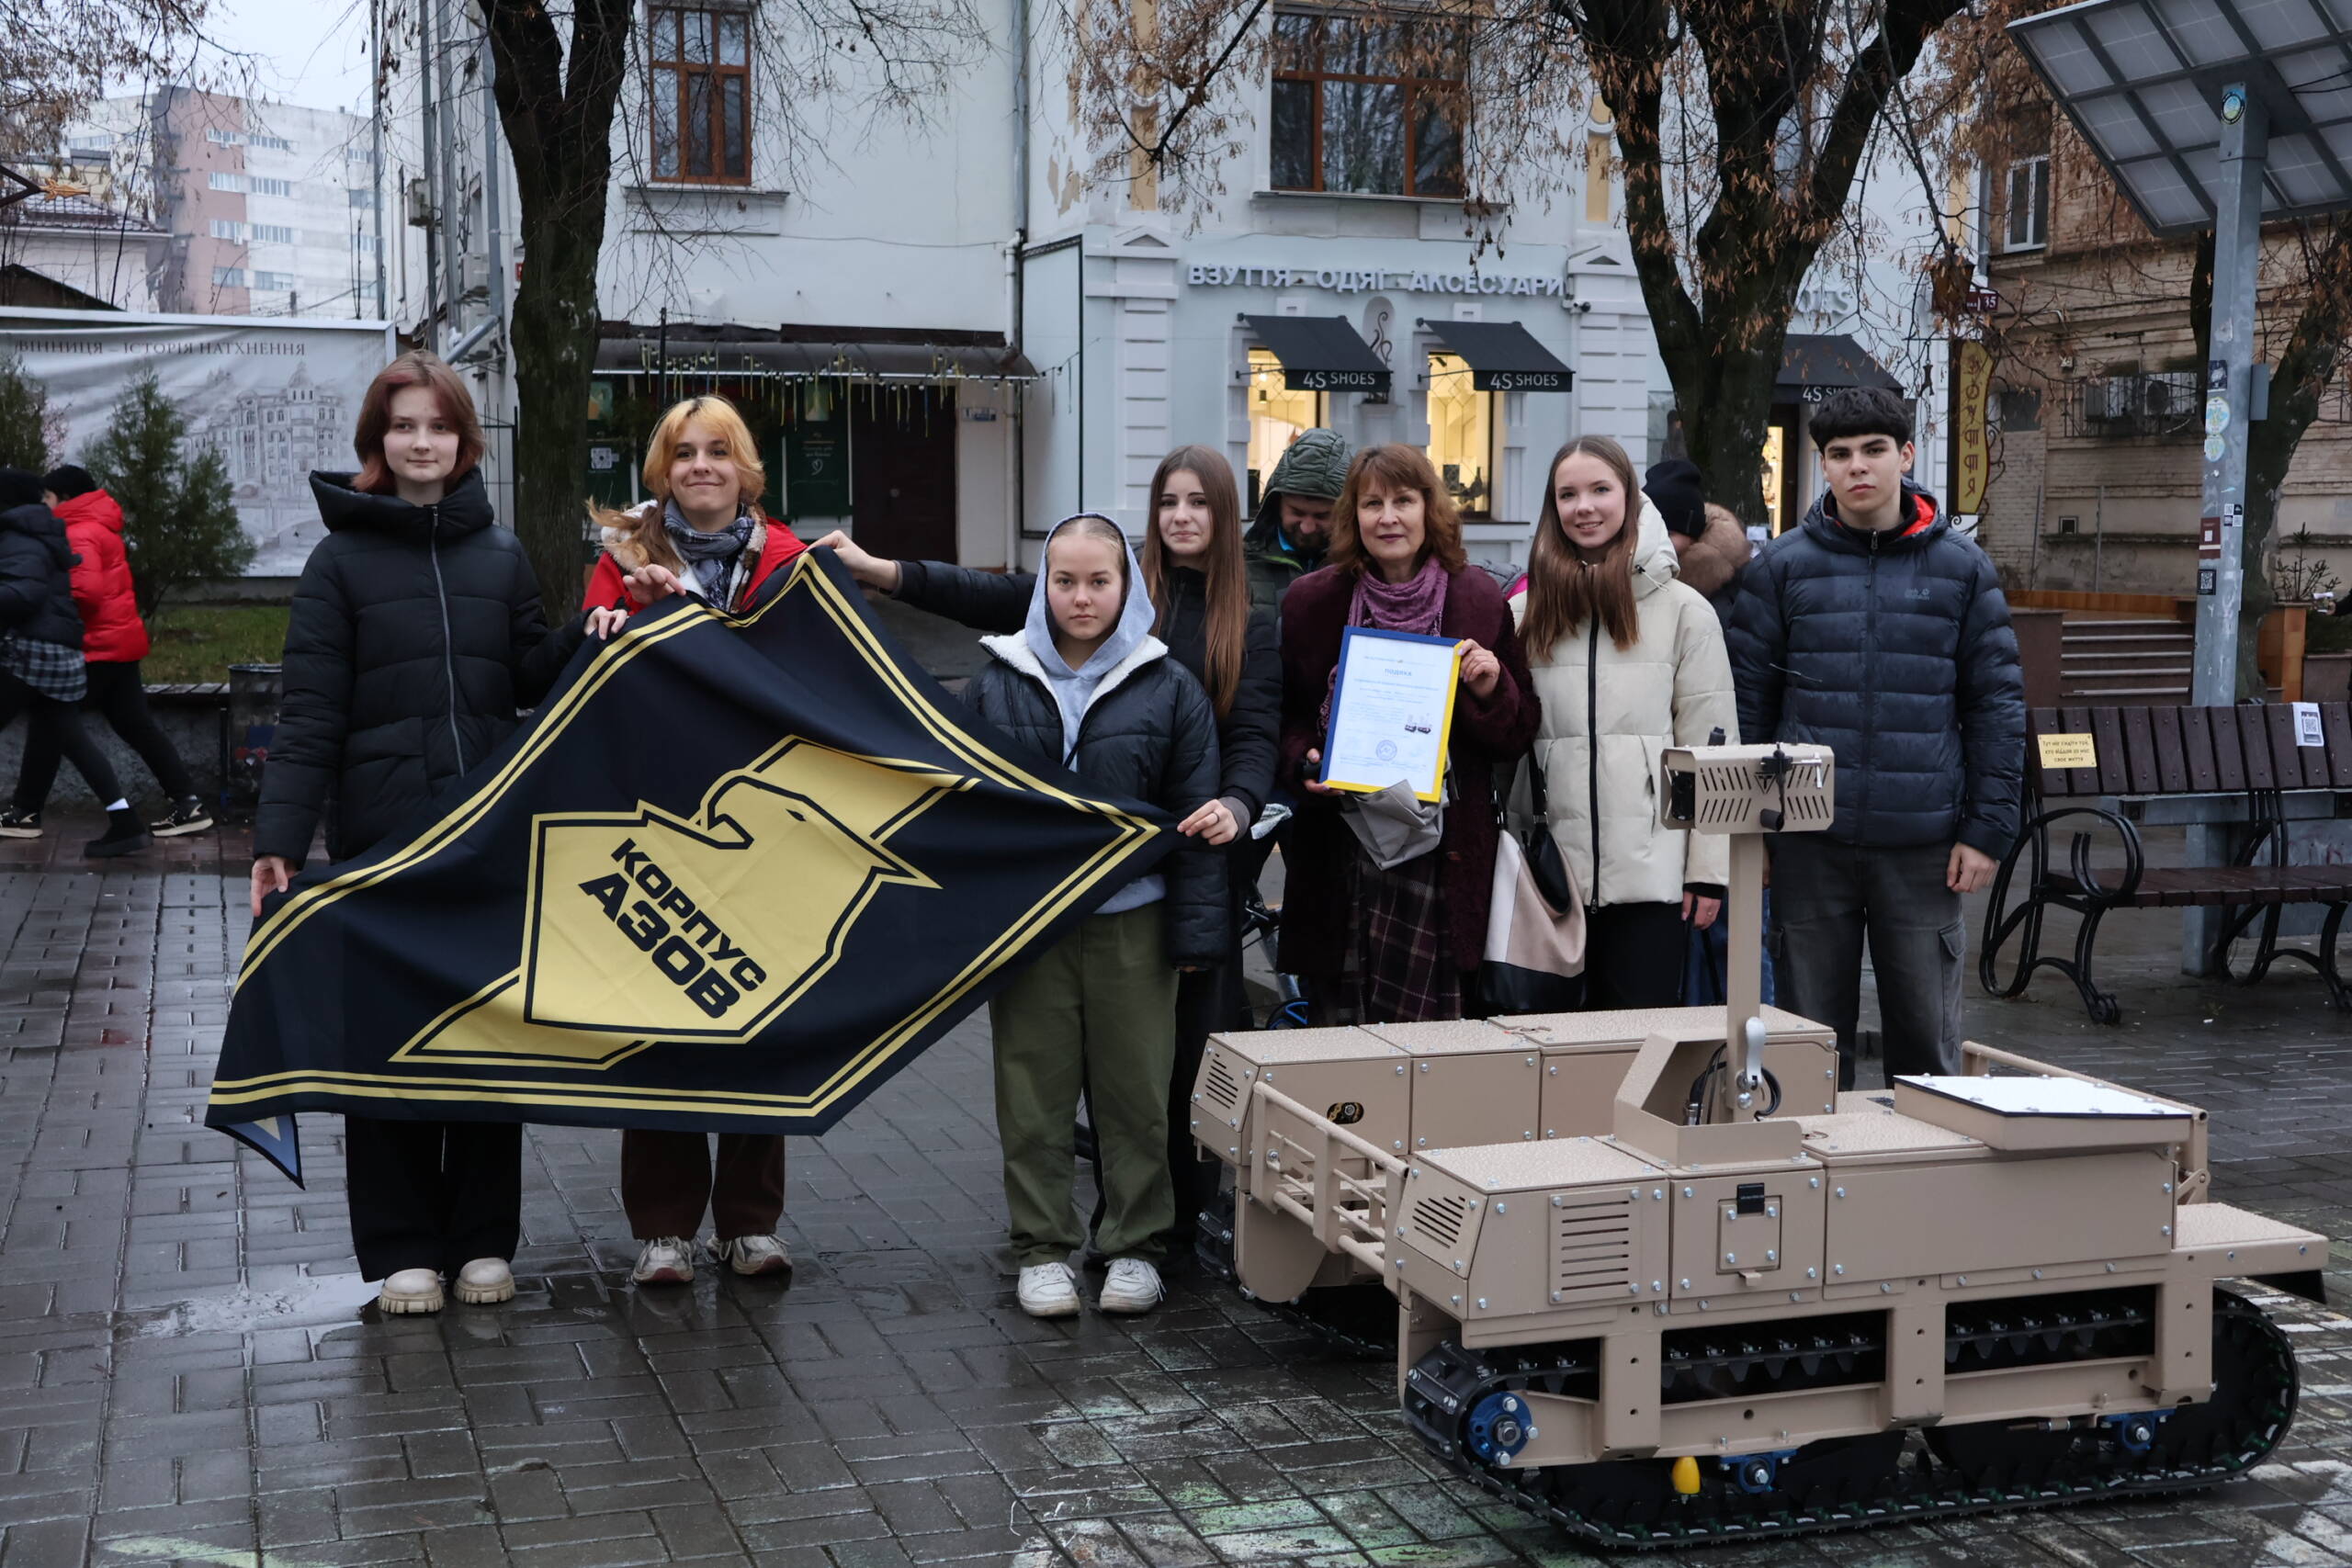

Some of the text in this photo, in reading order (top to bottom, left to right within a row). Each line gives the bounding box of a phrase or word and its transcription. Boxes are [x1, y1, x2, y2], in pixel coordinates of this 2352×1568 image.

[1187, 263, 1566, 297] ВЗУТТЯ ОДЯГ АКСЕСУАРИ
[17, 339, 103, 355] ВІННИЦЯ
[123, 341, 194, 355] ІСТОРІЯ
[198, 342, 306, 356] НАТХНЕННЯ
[1303, 371, 1375, 389] 4S SHOES
[1490, 373, 1559, 389] 4S SHOES
[1803, 386, 1823, 402] 4S
[611, 837, 767, 992] КОРПУС
[578, 872, 741, 1019] АЗОВ
